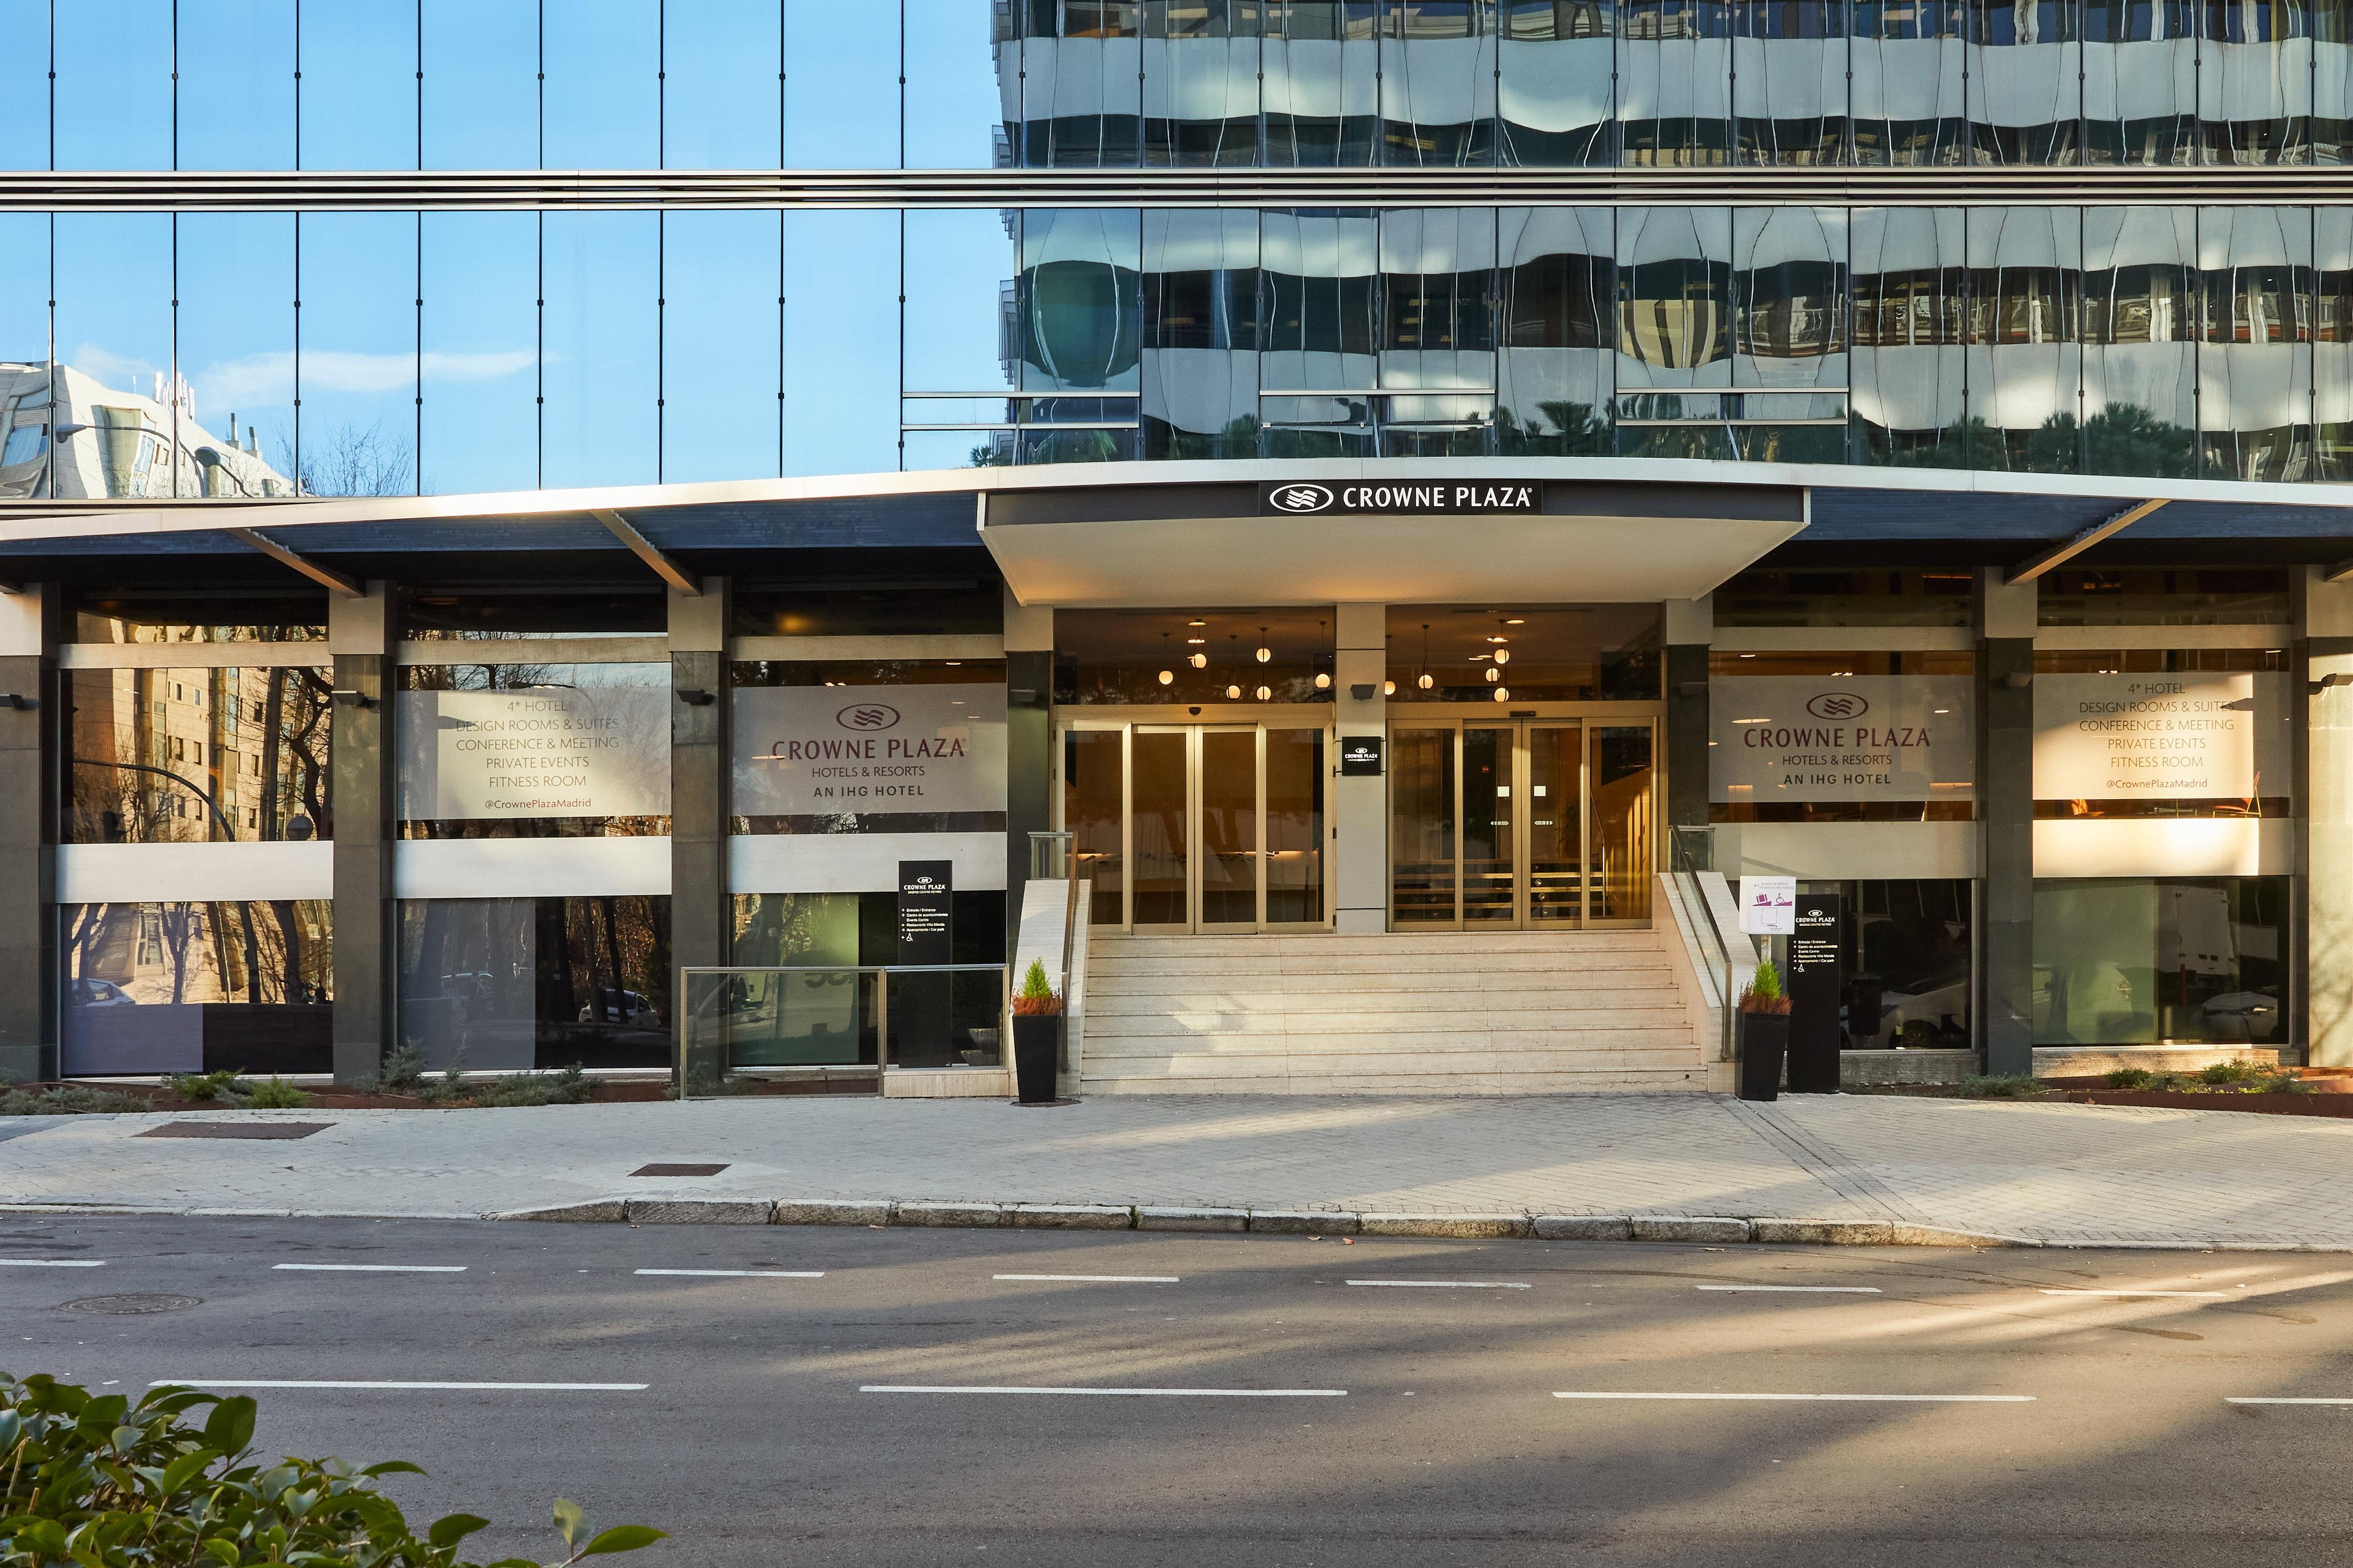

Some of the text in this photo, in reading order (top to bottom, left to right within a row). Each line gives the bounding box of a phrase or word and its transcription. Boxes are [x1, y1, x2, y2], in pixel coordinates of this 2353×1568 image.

[1343, 487, 1445, 507] CROWNE
[2145, 683, 2186, 694] HOTEL
[525, 700, 568, 711] HOTEL
[2080, 701, 2235, 713] DESIGN ROOMS & SUITES
[457, 718, 619, 732] DESIGN ROOMS & SUITES
[2080, 719, 2234, 732] CONFERENCE & MEETING
[456, 737, 620, 751] CONFERENCE & MEETING
[1744, 728, 1844, 748] CROWNE
[2108, 738, 2206, 749] PRIVATE EVENTS
[772, 739, 876, 760] CROWNE
[487, 756, 589, 769] PRIVATE EVENTS
[1783, 754, 1892, 765] HOTELS & RESORTS
[2111, 756, 2203, 768] FITNESS ROOM
[812, 765, 925, 778] HOTELS & RESORTS
[490, 775, 587, 788] FITNESS ROOM
[1784, 774, 1891, 784] AN IHG HOTEL
[2106, 779, 2208, 790] @CrownePlazaMadrid
[814, 785, 924, 797] AN IHG HOTEL
[485, 798, 591, 809] @CrownePlazaMadrid
